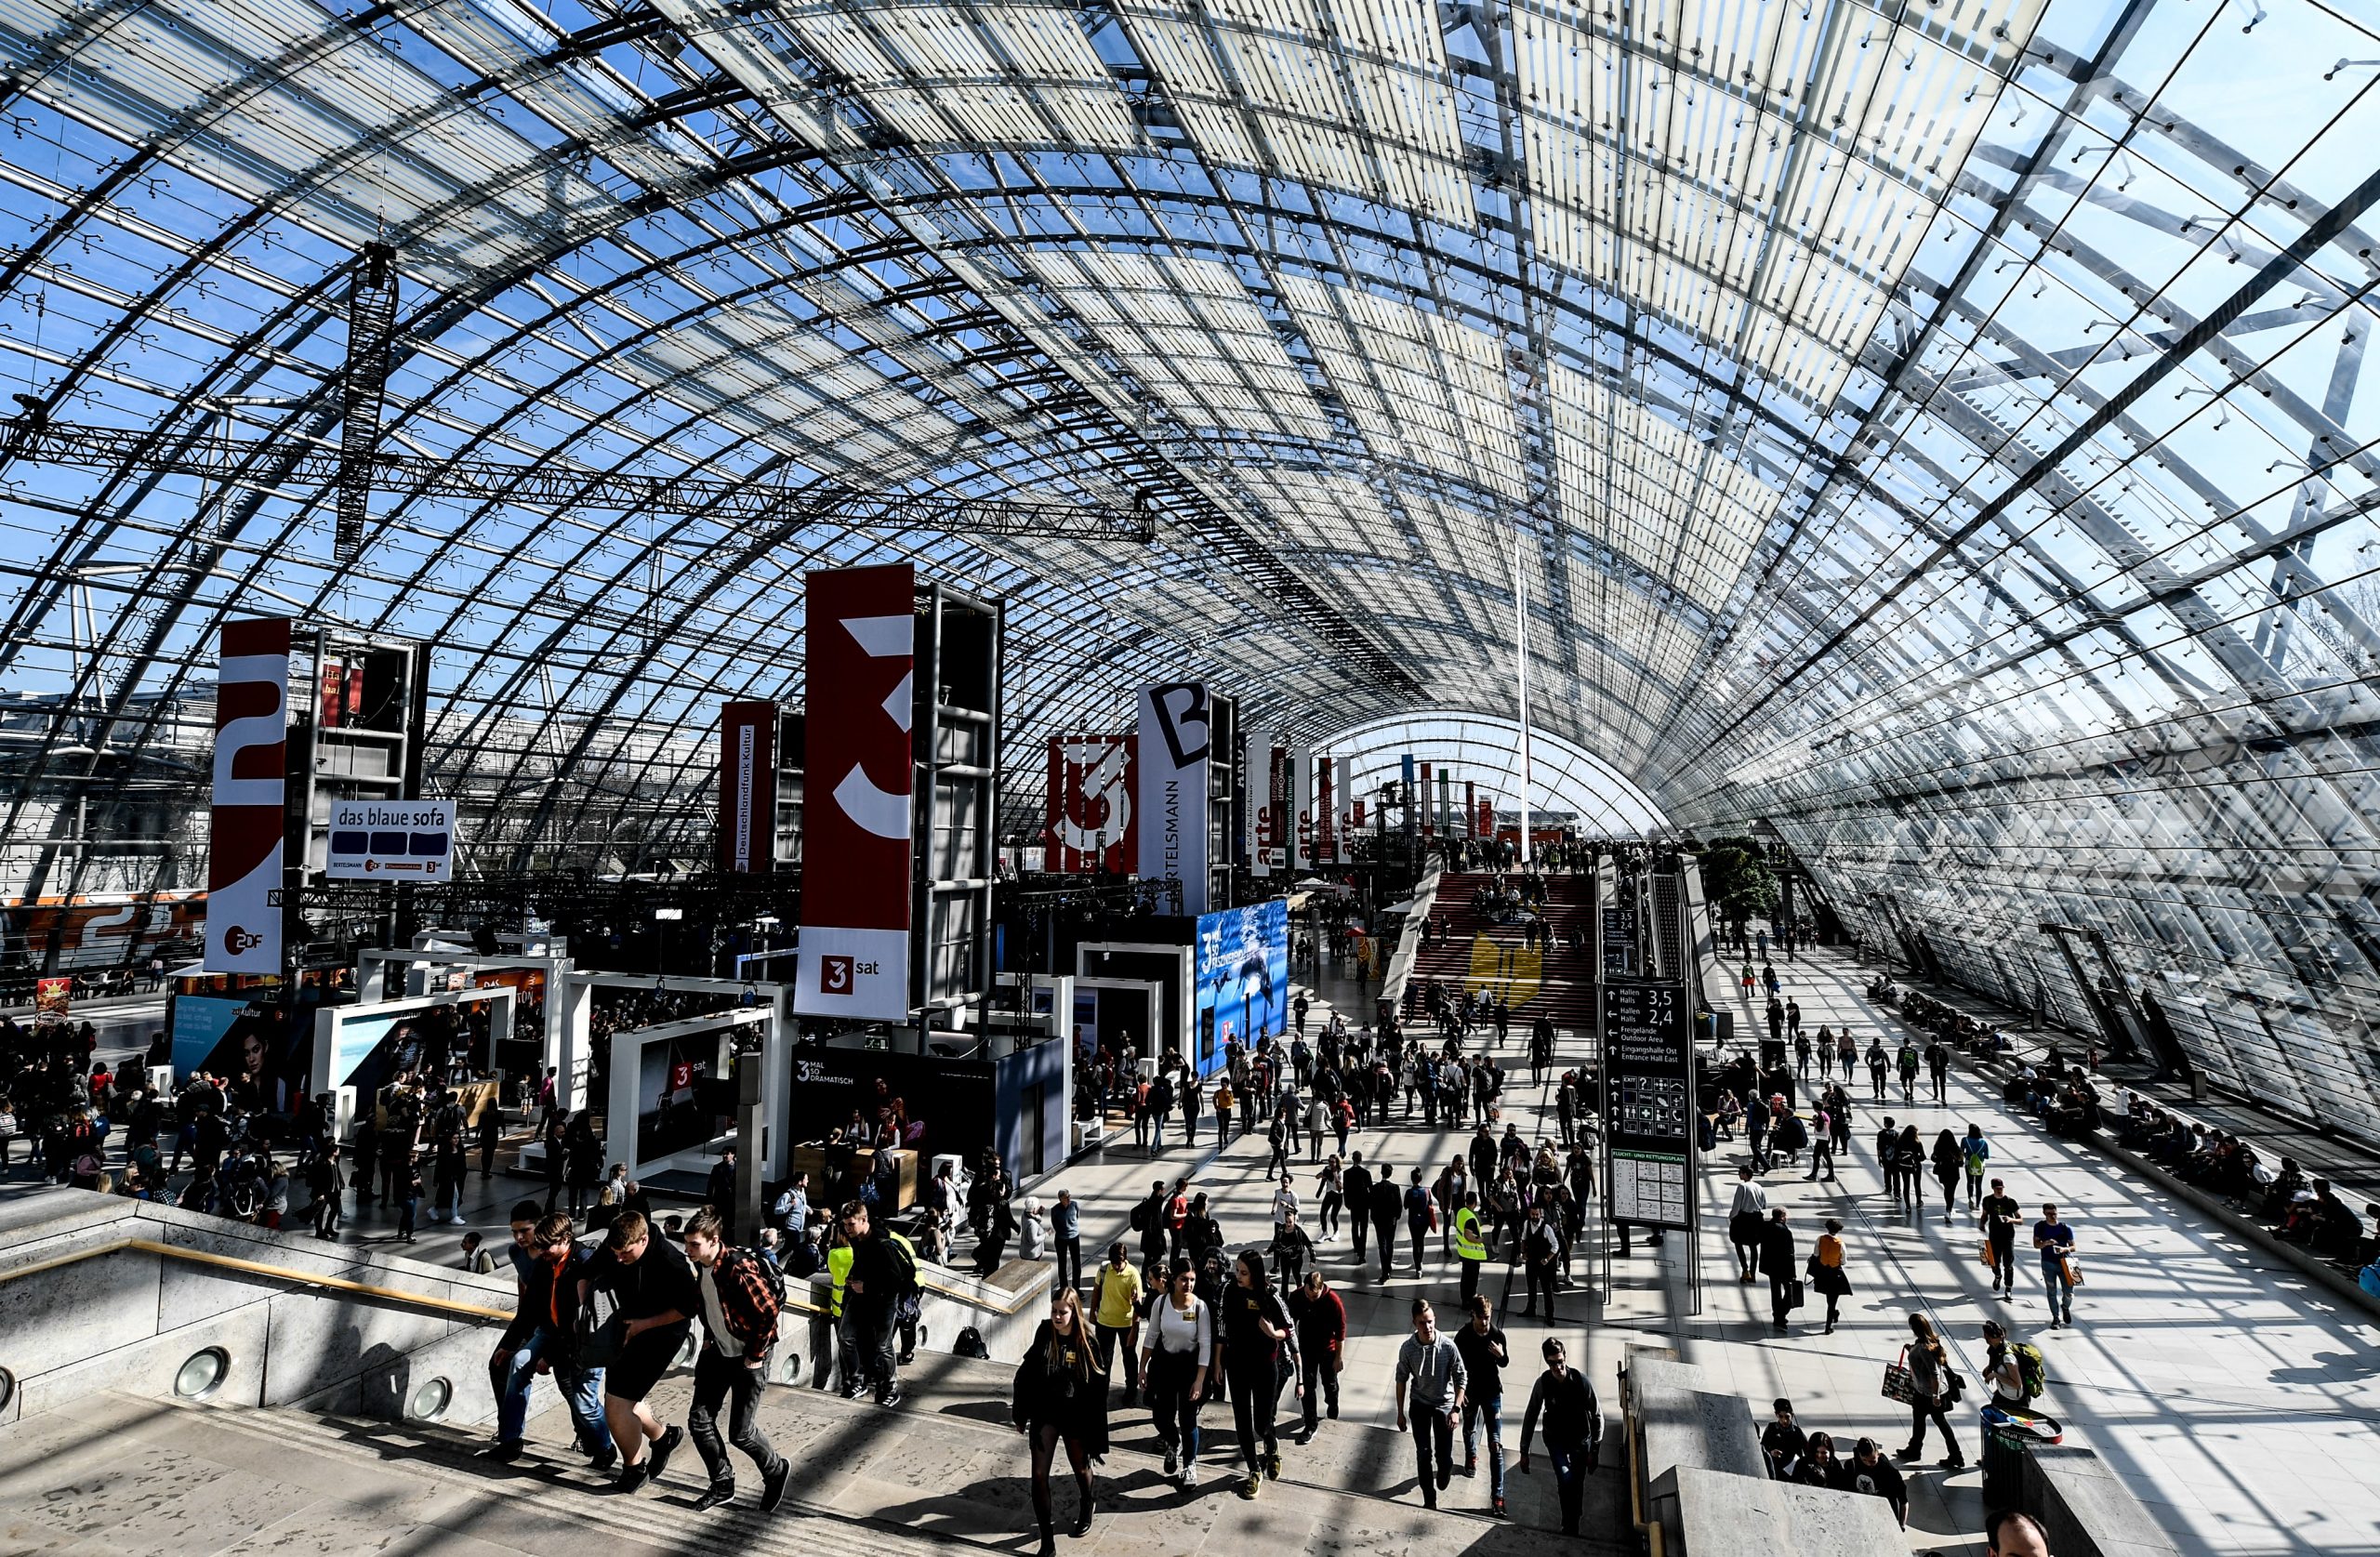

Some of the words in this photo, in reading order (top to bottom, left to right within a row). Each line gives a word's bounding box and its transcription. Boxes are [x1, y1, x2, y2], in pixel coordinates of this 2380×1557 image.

[742, 728, 751, 760] Kultur
[1286, 774, 1294, 801] Zeitung
[339, 808, 364, 826] das
[368, 808, 409, 826] blaue
[413, 808, 444, 826] sofa
[738, 763, 750, 855] Deutschlandfunk
[1165, 781, 1178, 903] BRTELSMANN
[1255, 806, 1271, 865] arte
[1298, 810, 1311, 860] arte
[1341, 811, 1353, 855] arte
[1648, 990, 1673, 1008] 3,5
[1649, 1009, 1673, 1026] 2,4
[1620, 1026, 1658, 1035] Freigelände
[1621, 1045, 1665, 1055] Eingangshalle
[1666, 1047, 1677, 1055] Ost
[1621, 1053, 1649, 1062] Entrance
[797, 1060, 810, 1082] 3
[810, 1061, 825, 1069] MAL
[810, 1075, 853, 1086] DRAMATISCH
[1646, 1154, 1685, 1162] RETTUNGSPLAN
